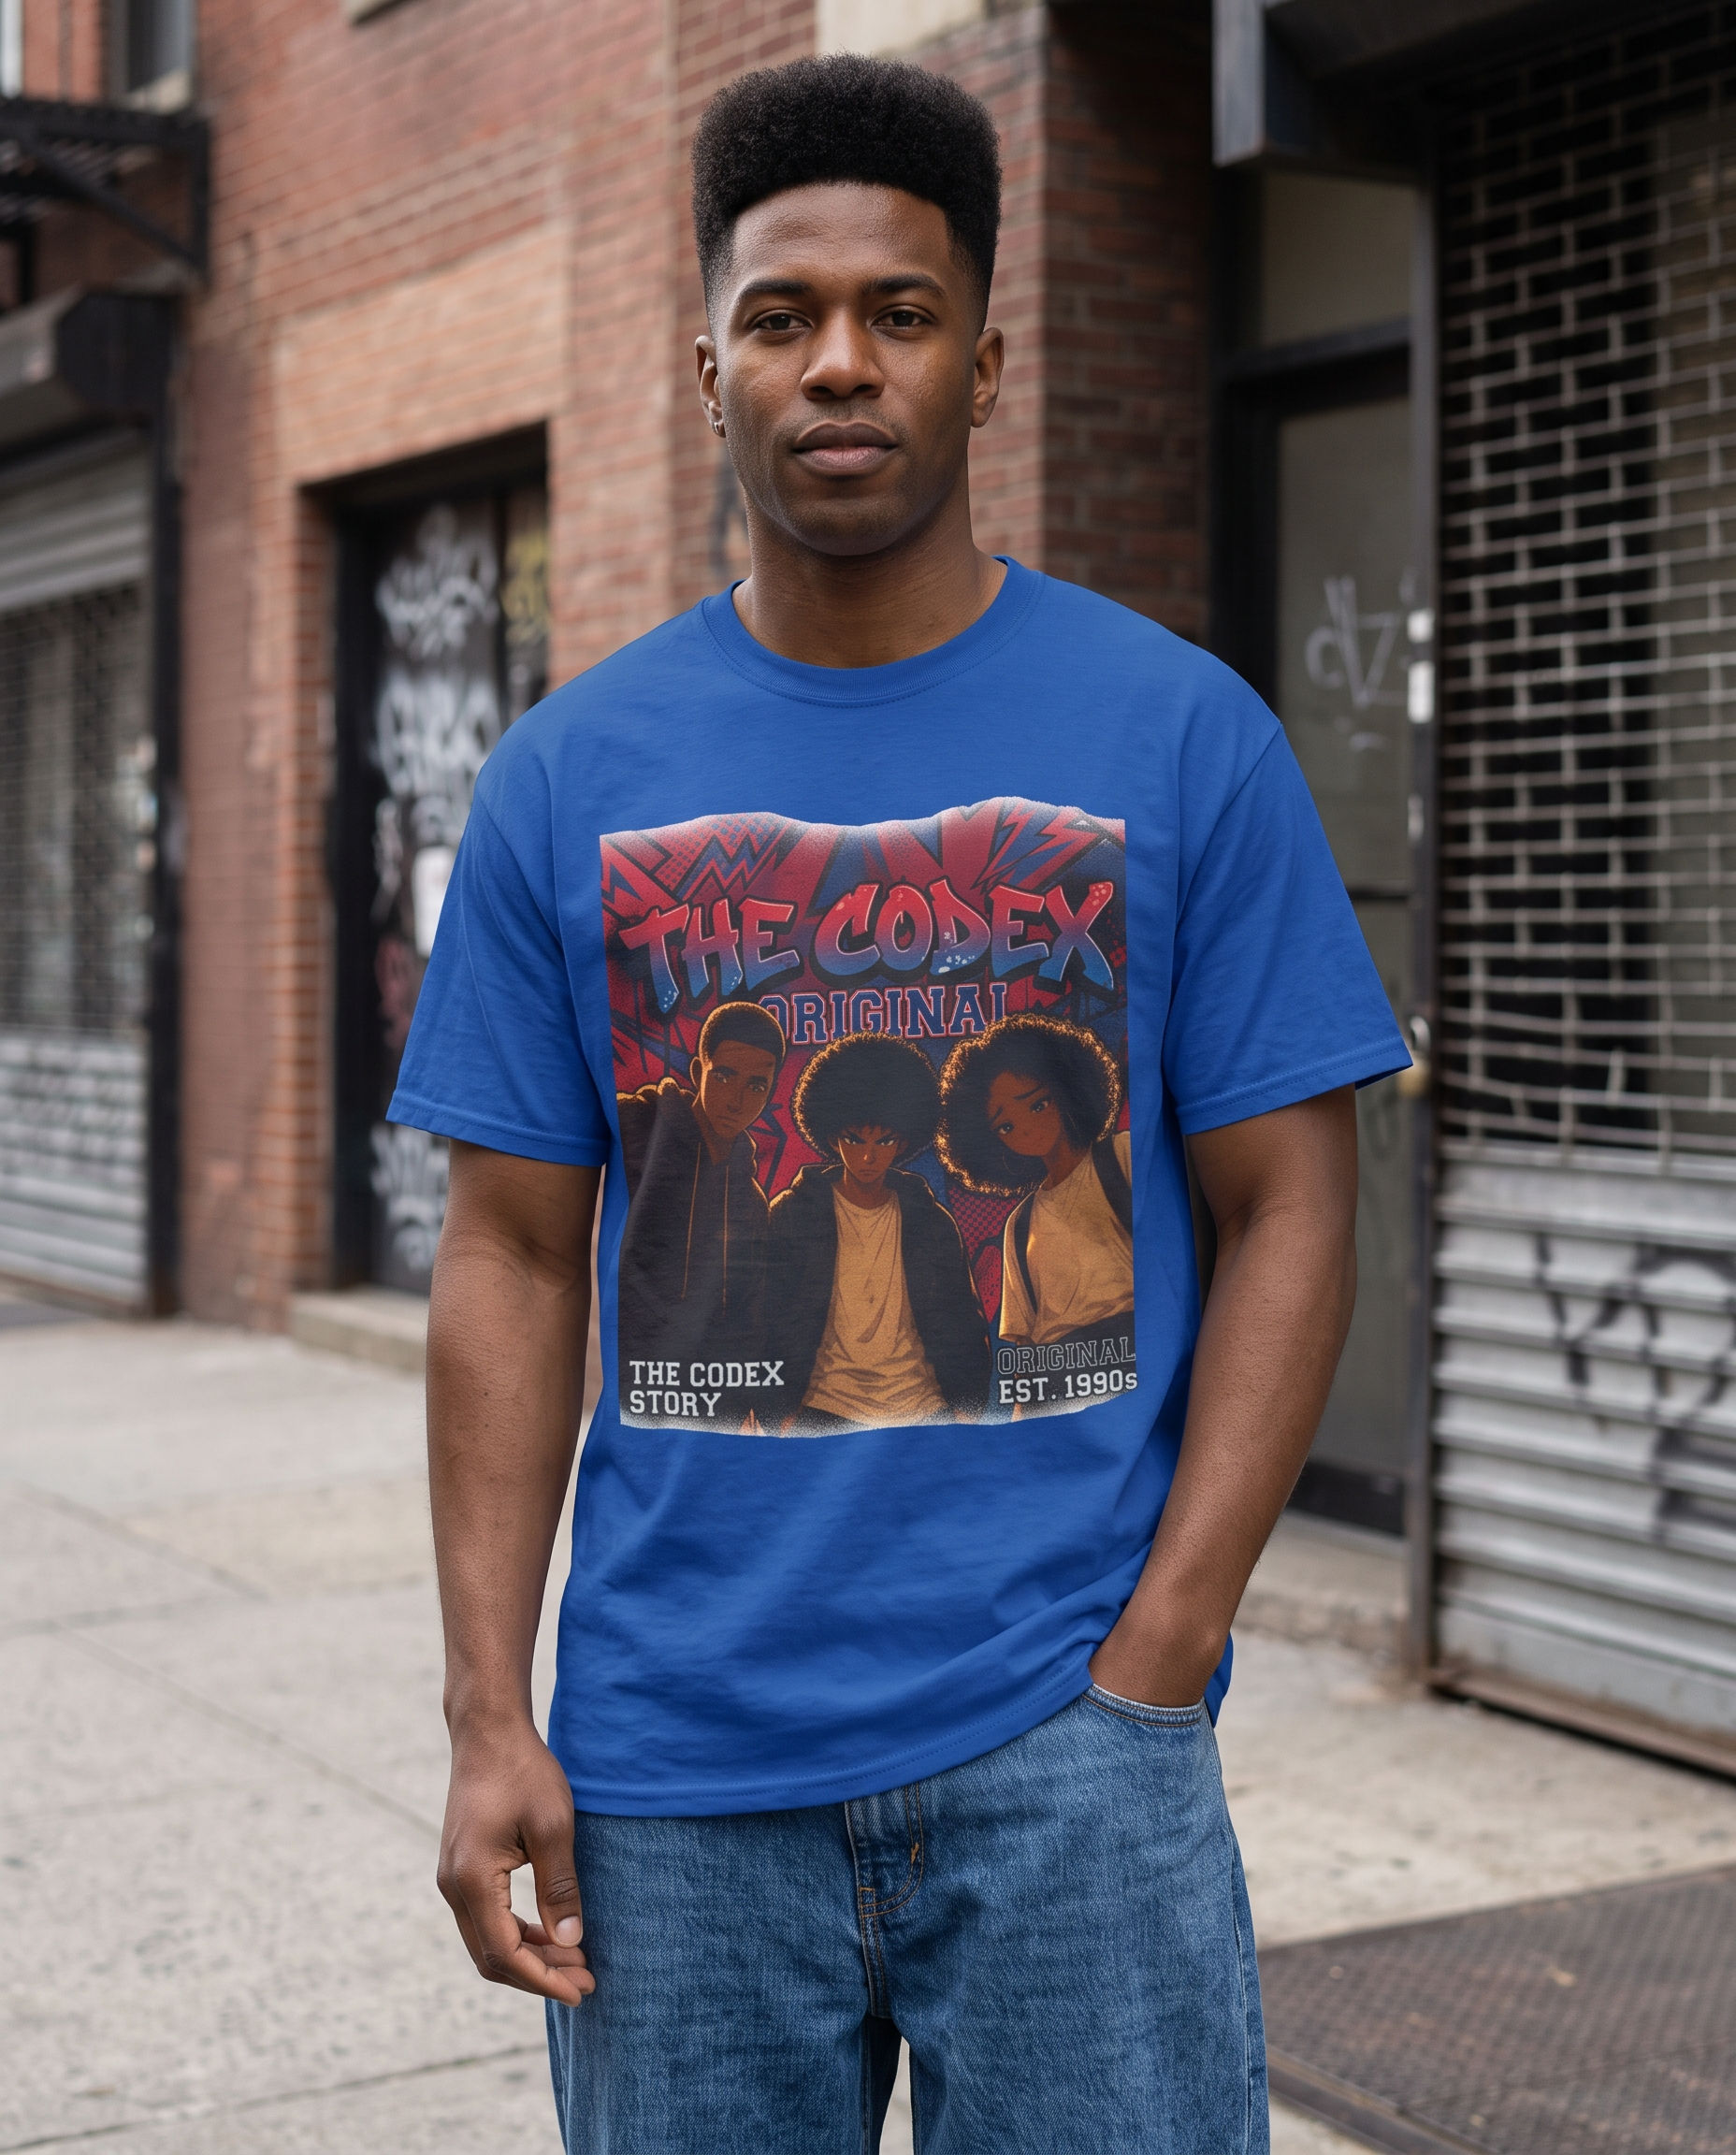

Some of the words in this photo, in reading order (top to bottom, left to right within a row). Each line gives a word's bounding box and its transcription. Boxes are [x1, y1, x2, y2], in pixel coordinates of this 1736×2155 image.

[618, 898, 800, 1014] THE
[813, 877, 1115, 991] CODEX
[629, 1360, 680, 1386] THE
[689, 1360, 785, 1387] CODEX
[997, 1336, 1136, 1375] ORIGINAL
[629, 1390, 722, 1417] STORY
[999, 1377, 1056, 1404] EST.
[1064, 1368, 1138, 1398] 1990s
